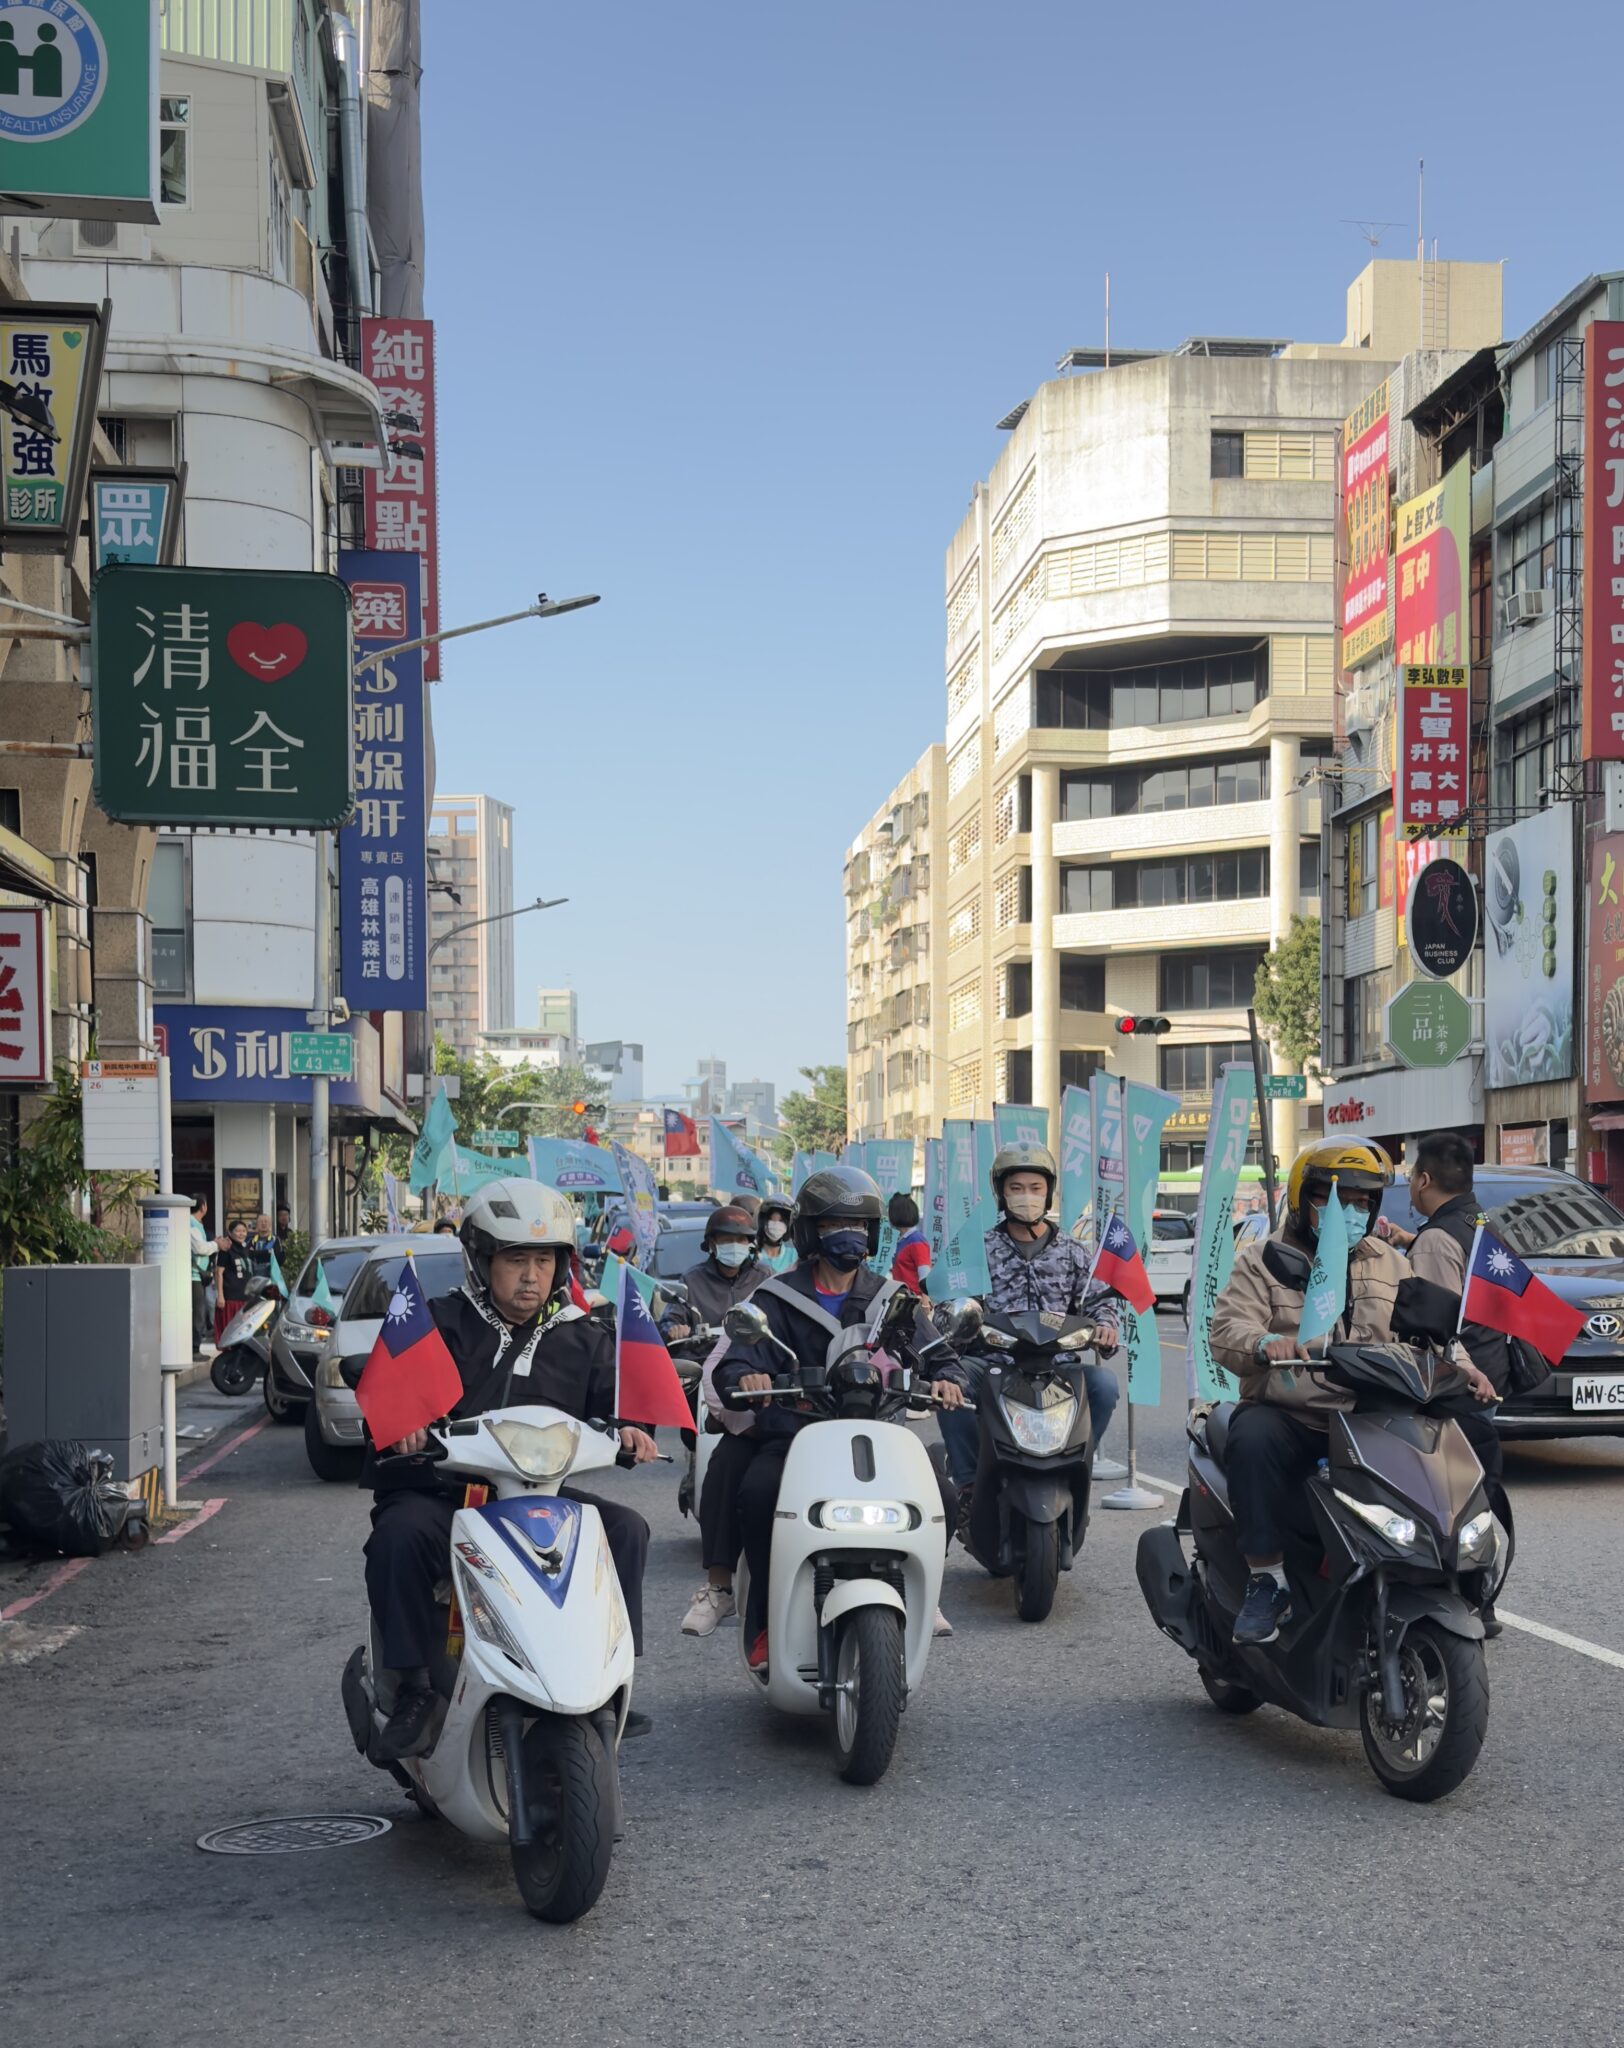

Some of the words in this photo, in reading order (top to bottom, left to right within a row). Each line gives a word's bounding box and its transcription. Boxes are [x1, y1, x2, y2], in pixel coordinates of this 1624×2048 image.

[49, 63, 97, 128] INSURANCE
[9, 487, 57, 521] 診所
[1401, 549, 1430, 601] 高中
[355, 590, 402, 631] 藥
[133, 603, 210, 691] 清
[1407, 668, 1465, 686] 李弘數學
[1420, 691, 1452, 739] 上智
[135, 701, 305, 793] 福全
[1410, 743, 1433, 819] 升高中
[1437, 743, 1460, 819] 升大學
[361, 877, 381, 979] 高雄林森店
[294, 1037, 348, 1047] 林森一路
[1411, 994, 1433, 1042] 三品
[89, 1082, 101, 1090] 26
[306, 1057, 322, 1070] 43
[1269, 1088, 1282, 1096] 2nd
[1283, 1087, 1292, 1096] Rd
